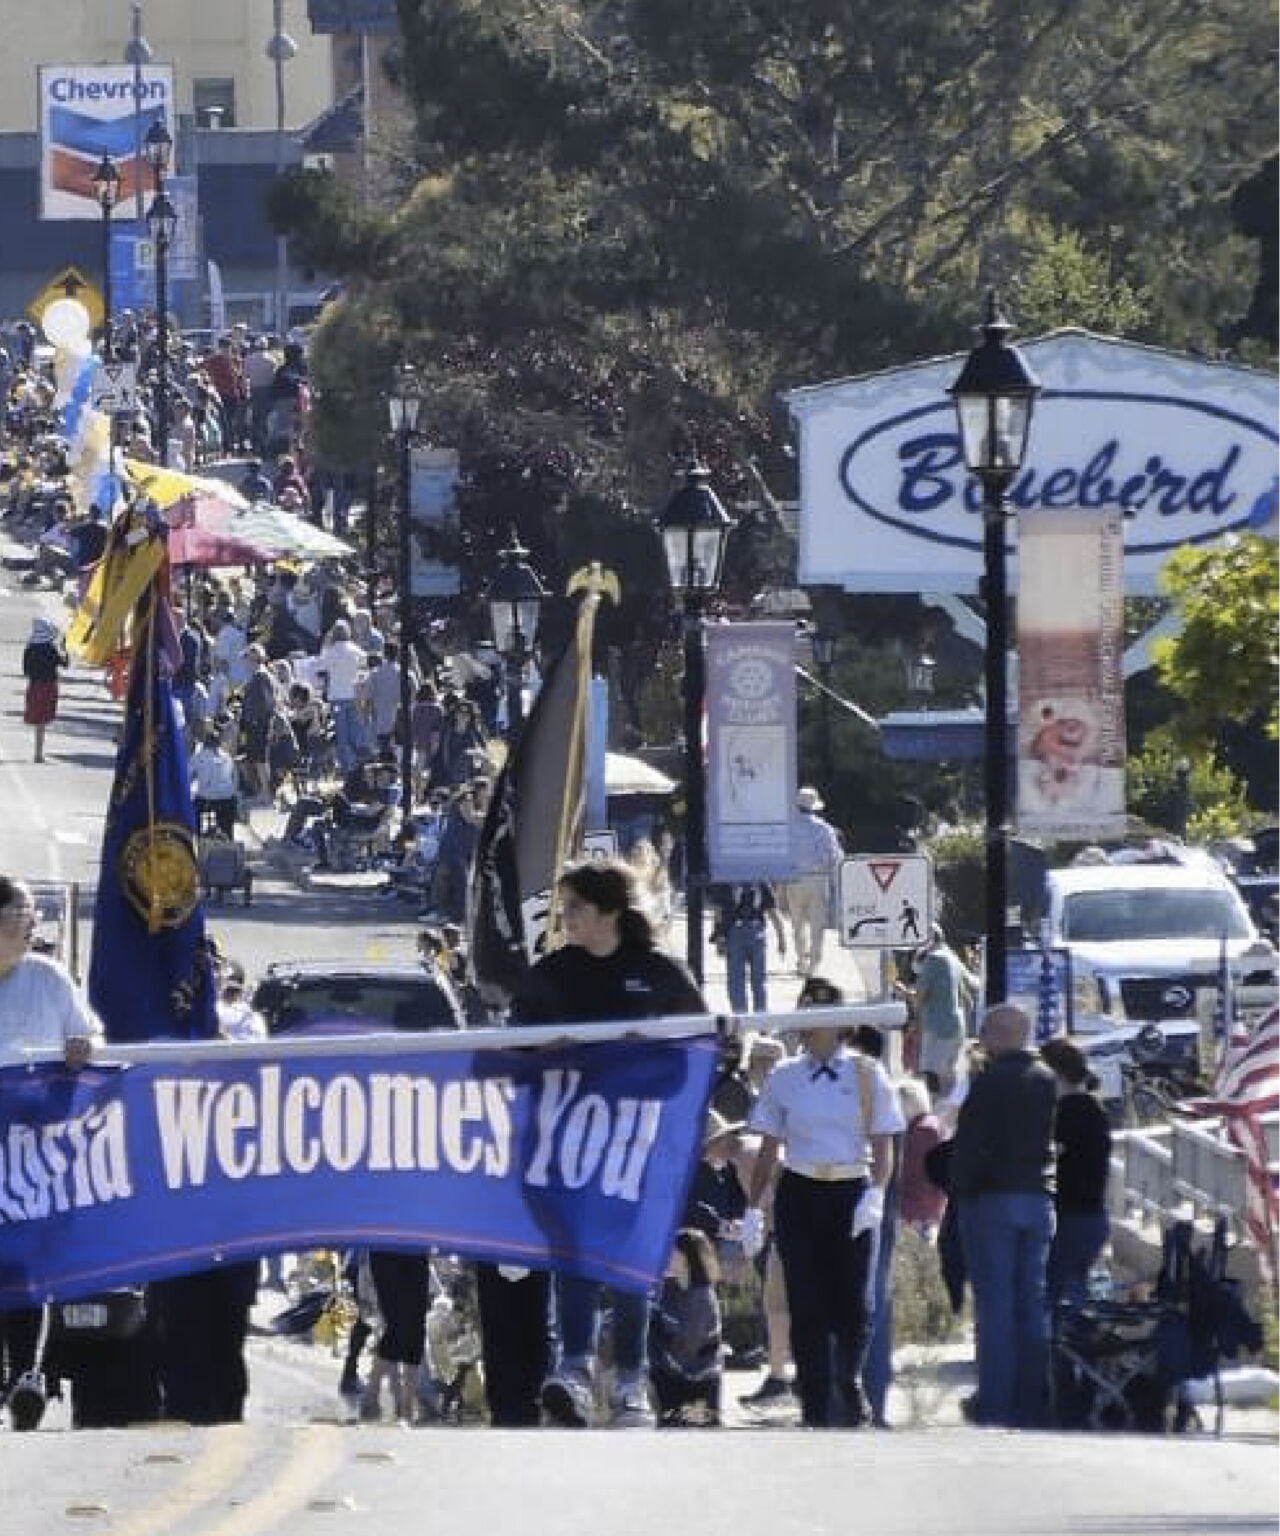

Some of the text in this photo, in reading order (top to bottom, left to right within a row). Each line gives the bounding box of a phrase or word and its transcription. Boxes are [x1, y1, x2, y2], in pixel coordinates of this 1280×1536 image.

[49, 77, 166, 102] Chevron
[152, 1065, 517, 1190] Welcomes
[523, 1068, 662, 1202] You
